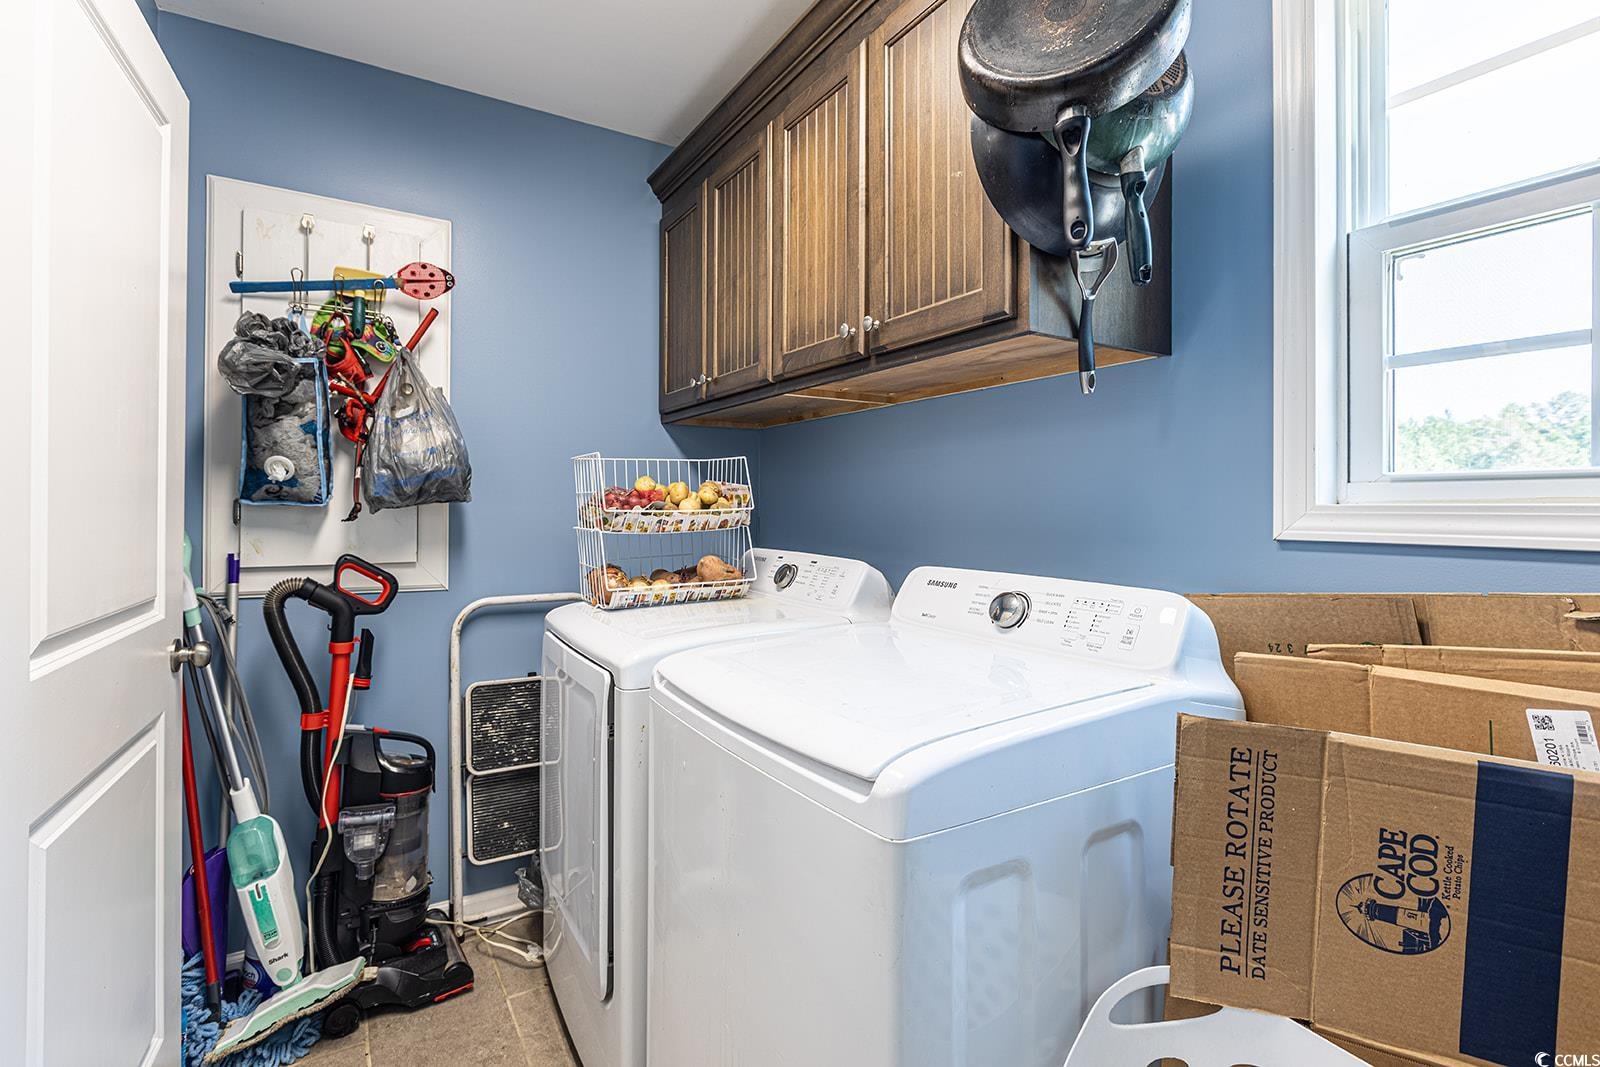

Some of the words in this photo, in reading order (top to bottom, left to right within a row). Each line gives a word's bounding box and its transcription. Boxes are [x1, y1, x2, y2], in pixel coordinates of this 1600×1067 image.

[927, 579, 958, 589] SAMSUNG
[1225, 747, 1252, 860] ROTATE
[1259, 750, 1278, 834] PRODUCT
[1373, 828, 1407, 899] CAPE
[1443, 846, 1454, 875] Cooked
[1454, 854, 1465, 875] Chips
[1254, 837, 1272, 928] SENSITIVE
[1442, 876, 1452, 900] Kettle
[1452, 876, 1462, 900] Potato
[1220, 866, 1246, 976] PLEASE
[268, 952, 288, 965] Shark
[1252, 931, 1267, 980] DATE
